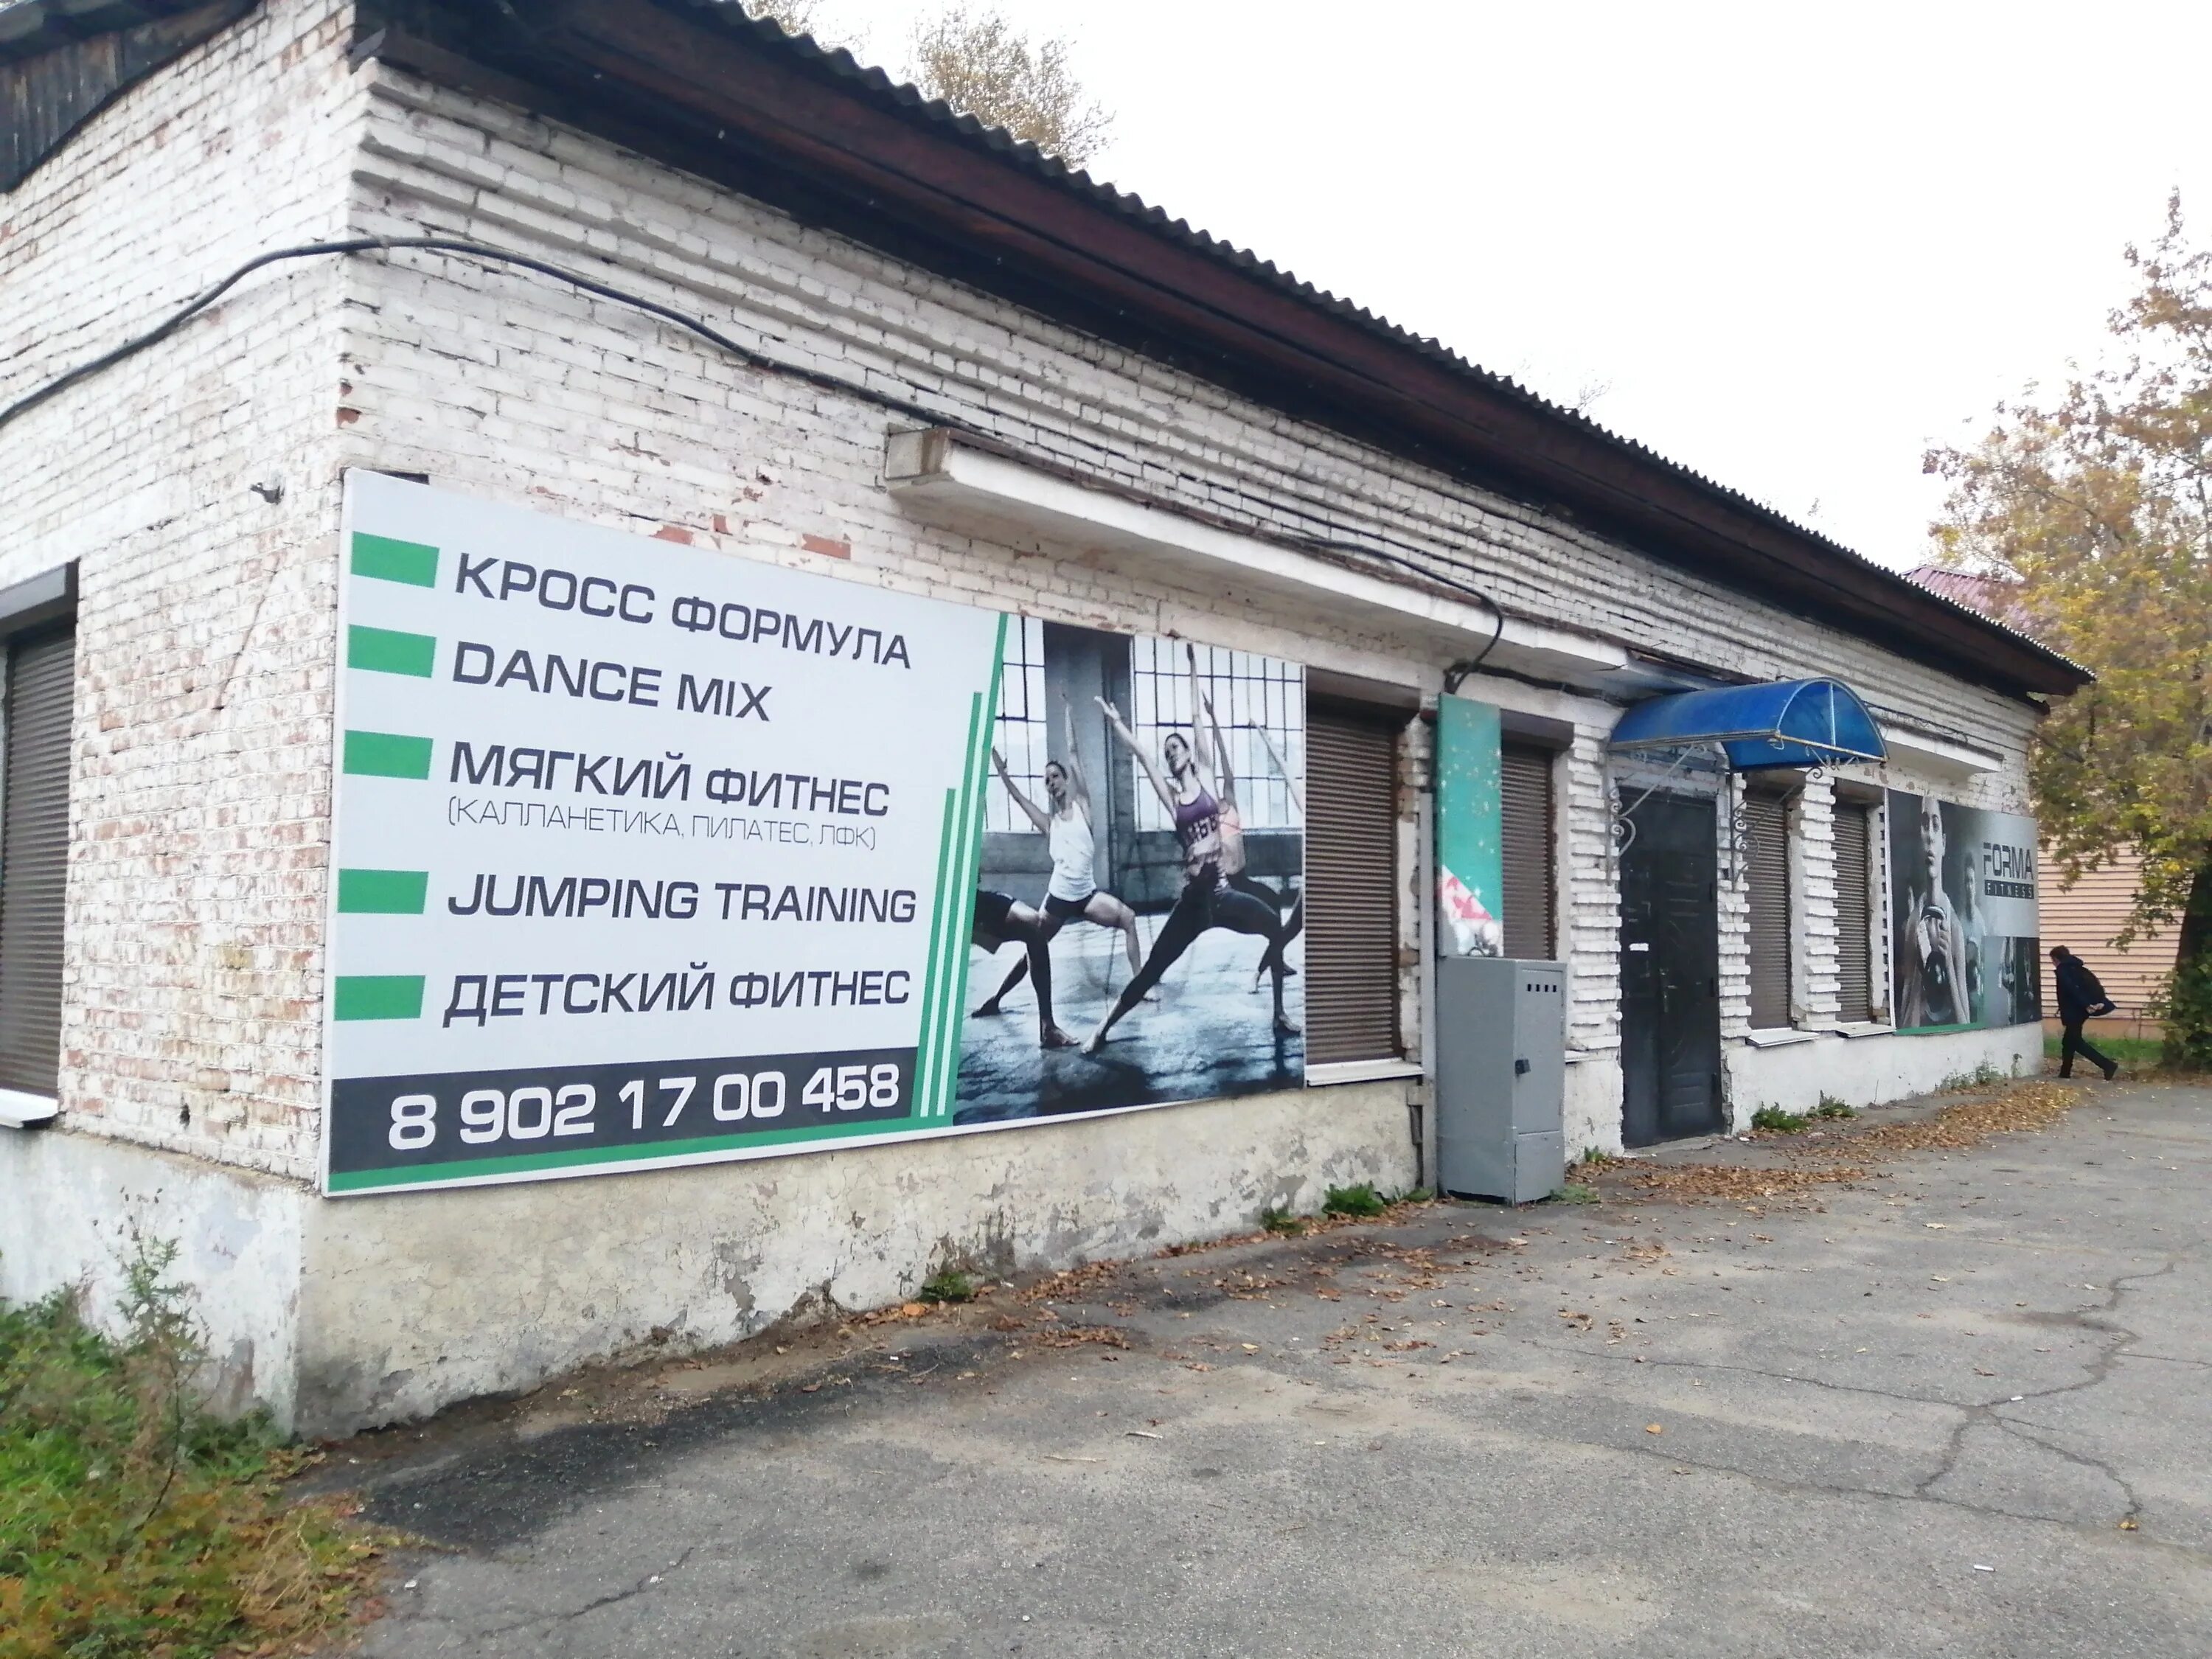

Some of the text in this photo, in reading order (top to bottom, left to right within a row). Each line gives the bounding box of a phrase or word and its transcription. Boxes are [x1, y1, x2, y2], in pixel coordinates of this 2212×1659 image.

[456, 553, 911, 669] КРОСС ФОРМУЛА
[453, 641, 772, 722] DANCE MIX
[451, 742, 889, 816] МЯГКИЙ ФИТНЕС
[448, 796, 876, 851] (КАЛЛАНЕТИКА, ПИЛАТЕС, ЛФК)
[1983, 842, 2034, 880] FORMA
[1986, 883, 2032, 898] FITNESS
[448, 874, 917, 923] JUMPING TRAINING
[443, 962, 911, 1028] ДЕТСКИЙ ФИТНЕС
[389, 1064, 900, 1150] 8 902 17 00 458
